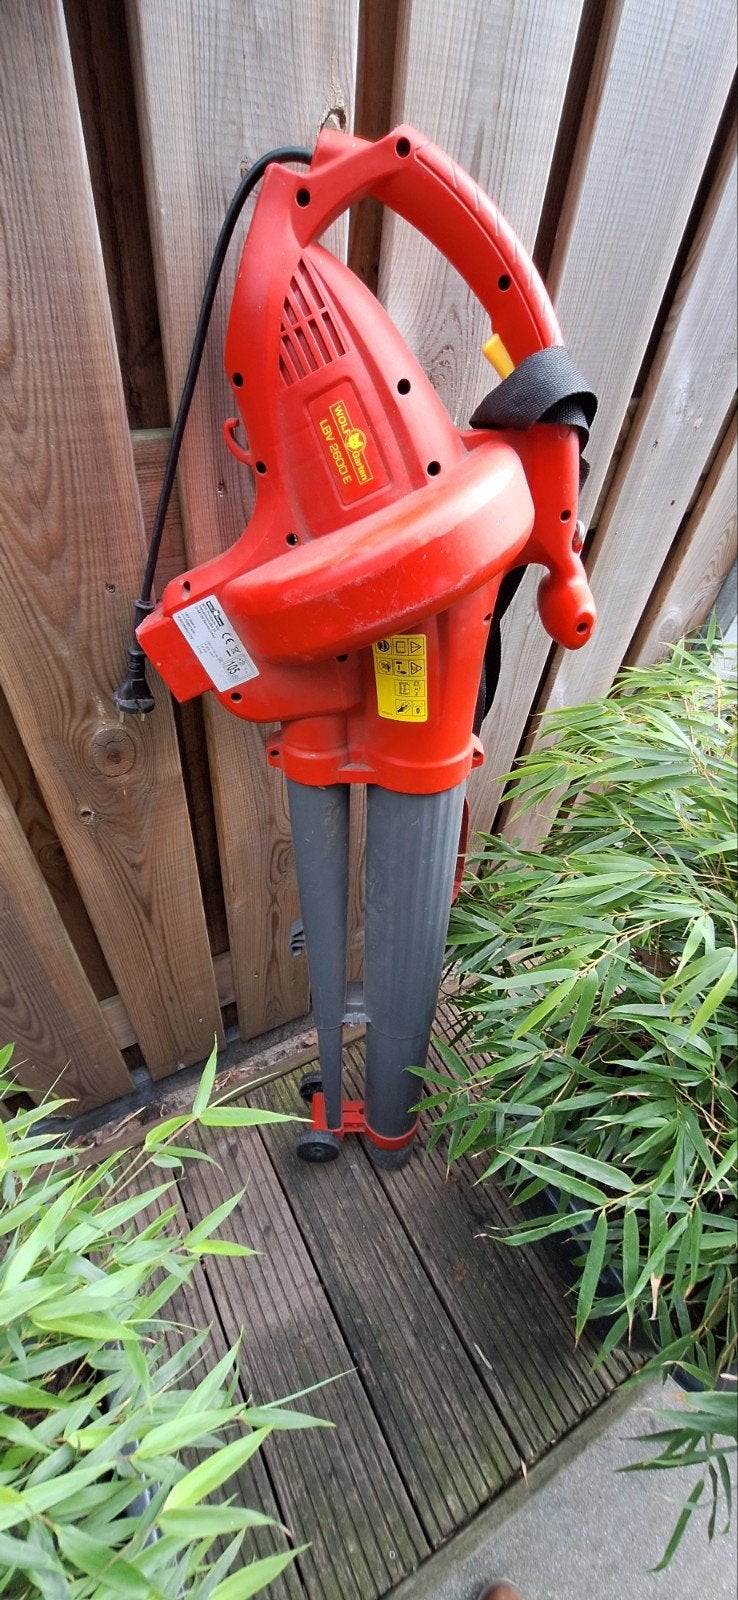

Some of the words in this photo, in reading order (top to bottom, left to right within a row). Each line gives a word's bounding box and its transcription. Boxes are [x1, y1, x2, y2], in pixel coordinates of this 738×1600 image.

[319, 419, 336, 441] LBV
[329, 443, 348, 476] 2600
[342, 475, 352, 485] E
[334, 405, 352, 436] WOLF
[352, 451, 368, 481] Garten
[227, 661, 240, 675] 105
